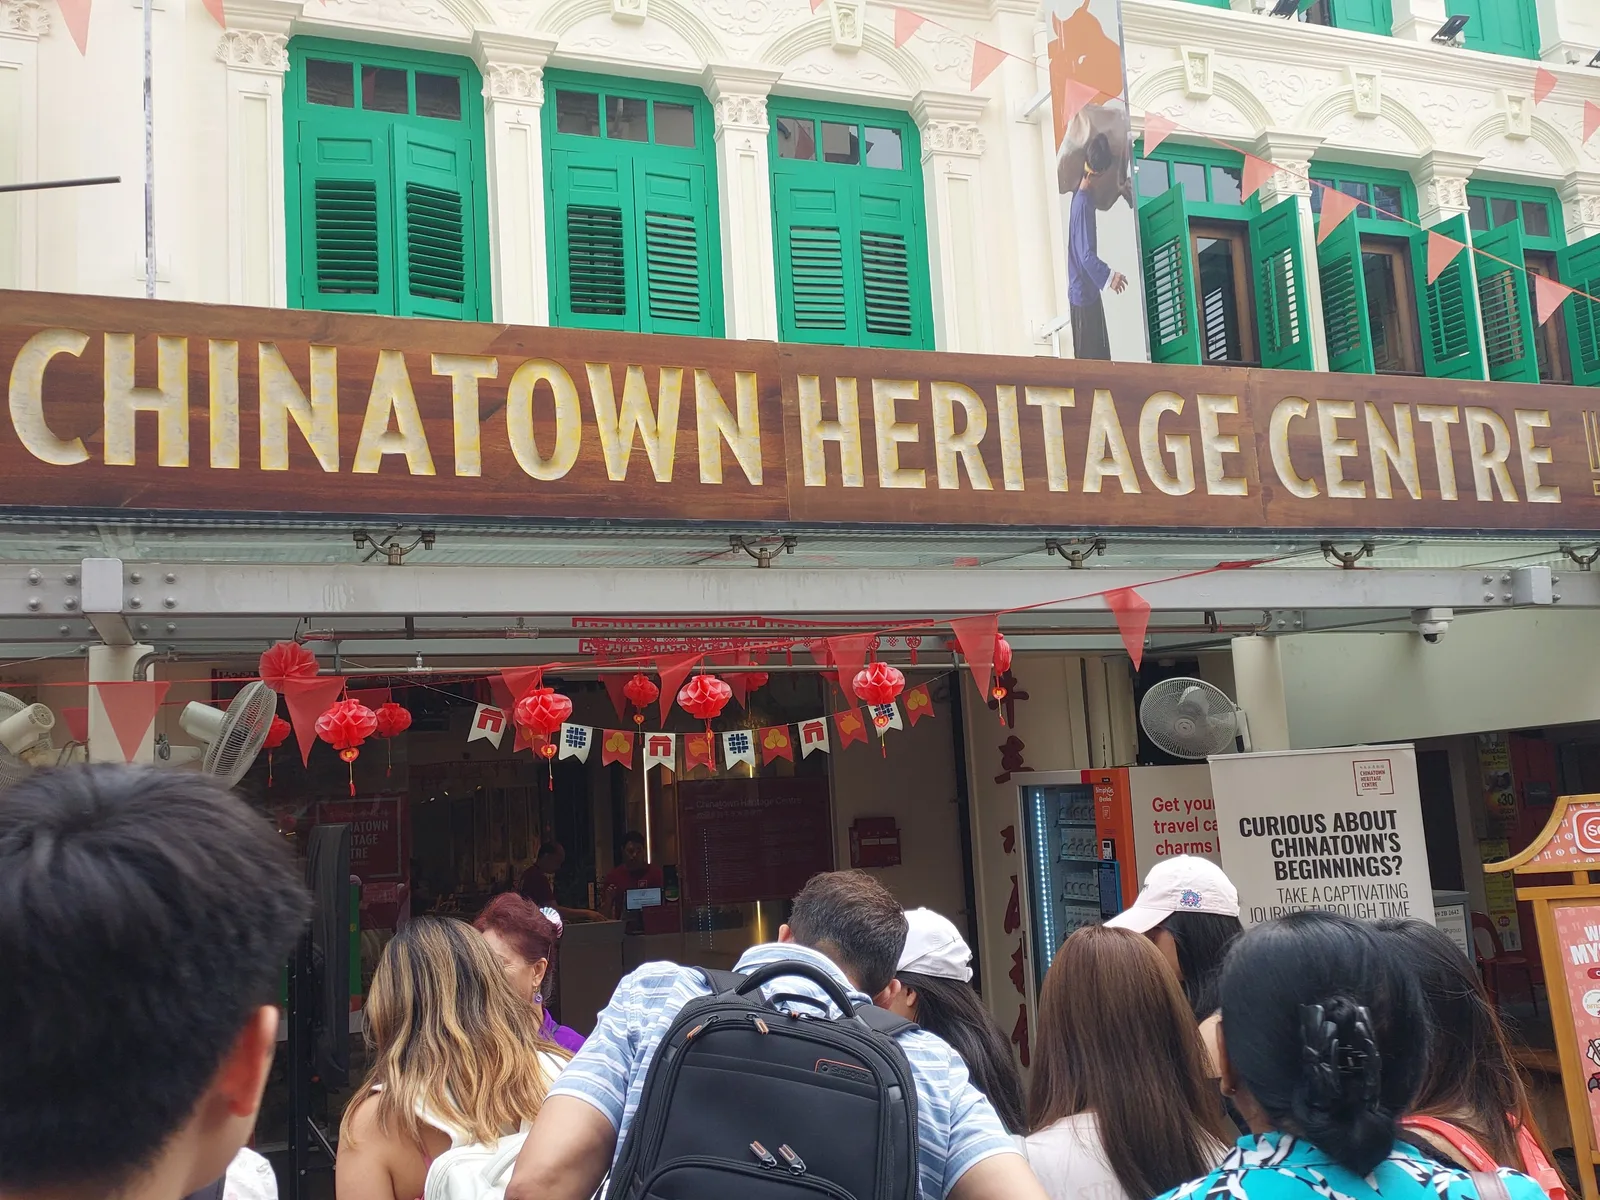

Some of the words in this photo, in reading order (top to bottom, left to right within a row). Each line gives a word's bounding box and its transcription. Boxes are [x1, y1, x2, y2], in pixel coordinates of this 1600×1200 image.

[8, 328, 764, 486] CHINATOWN
[797, 374, 1249, 498] HERITAGE
[1268, 395, 1561, 504] CENTRE
[1151, 796, 1181, 813] Get
[1153, 816, 1199, 834] travel
[1238, 813, 1328, 837] CURIOUS
[1332, 809, 1398, 833] ABOUT
[1587, 824, 1600, 837] S
[1155, 839, 1213, 856] charms
[1270, 832, 1402, 858] CHINATOWN'S
[1273, 855, 1403, 880] BEGINNINGS?
[1276, 887, 1310, 904] TAKE
[1312, 886, 1321, 902] A
[1323, 882, 1409, 902] CAPTIVATING
[1379, 901, 1412, 918] TIME
[1583, 924, 1600, 942] W
[1569, 942, 1600, 966] MY
